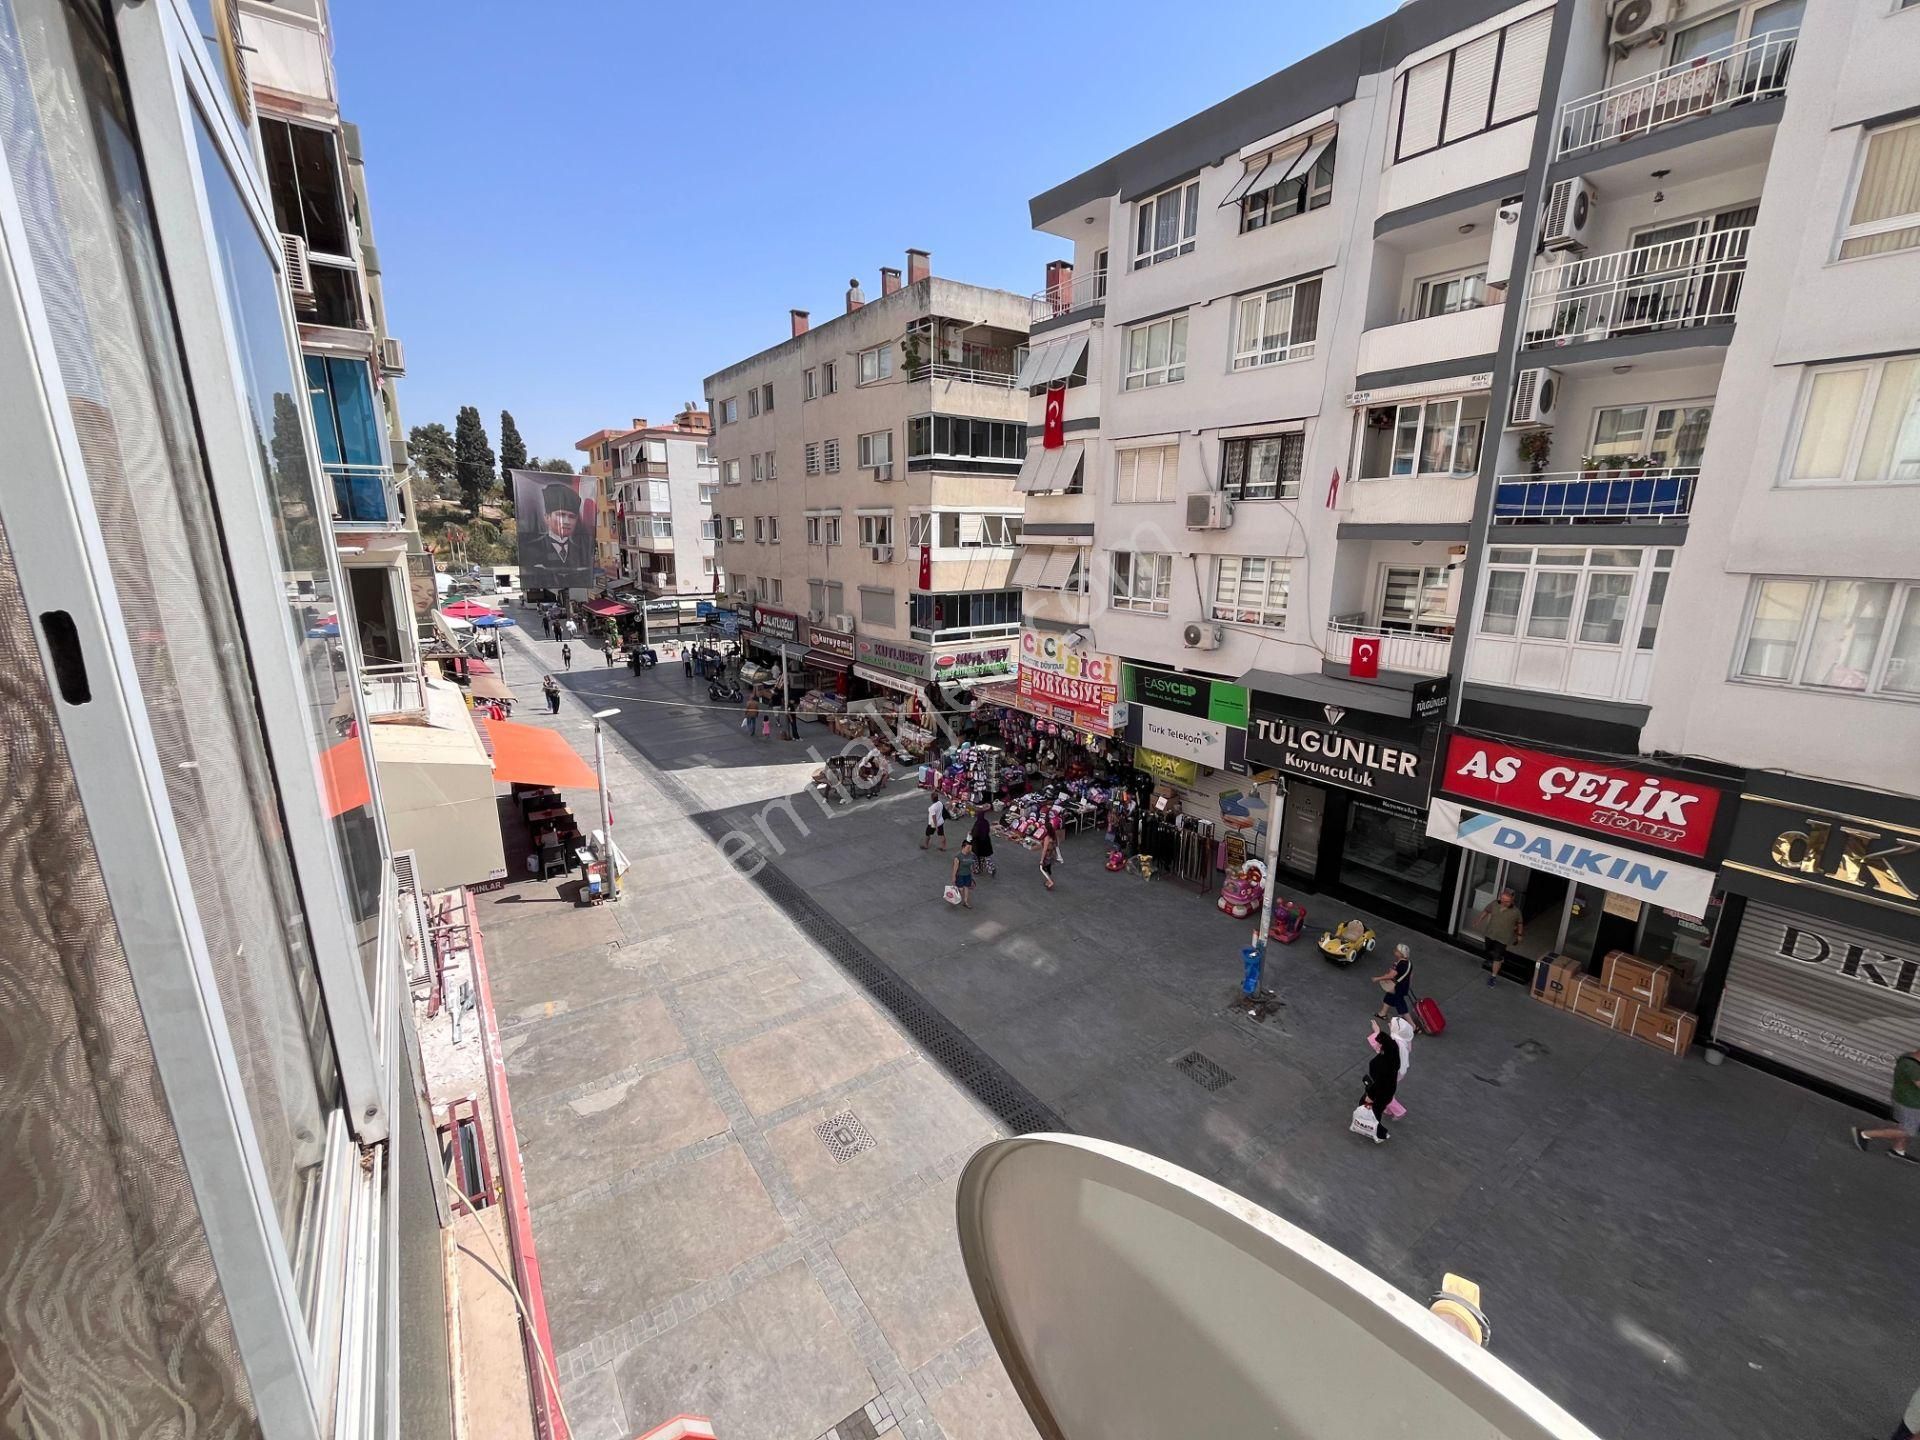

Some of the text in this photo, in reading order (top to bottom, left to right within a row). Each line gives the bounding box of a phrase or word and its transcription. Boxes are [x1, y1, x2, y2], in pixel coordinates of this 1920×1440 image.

[1032, 669, 1101, 704] KIRTASİYE
[1144, 676, 1197, 697] EASYCEP
[1416, 696, 1448, 712] TÜLGÜNLER
[1148, 723, 1202, 745] Türk Telekom
[1255, 719, 1423, 778] TÜLGÜNLER
[1151, 754, 1162, 766] 18
[1164, 758, 1180, 772] AY
[1284, 751, 1375, 788] Kuyumculuk
[1457, 749, 1700, 828] AS ÇELİK
[1590, 808, 1687, 843] TİCARET
[1492, 826, 1669, 892] DAIKIN
